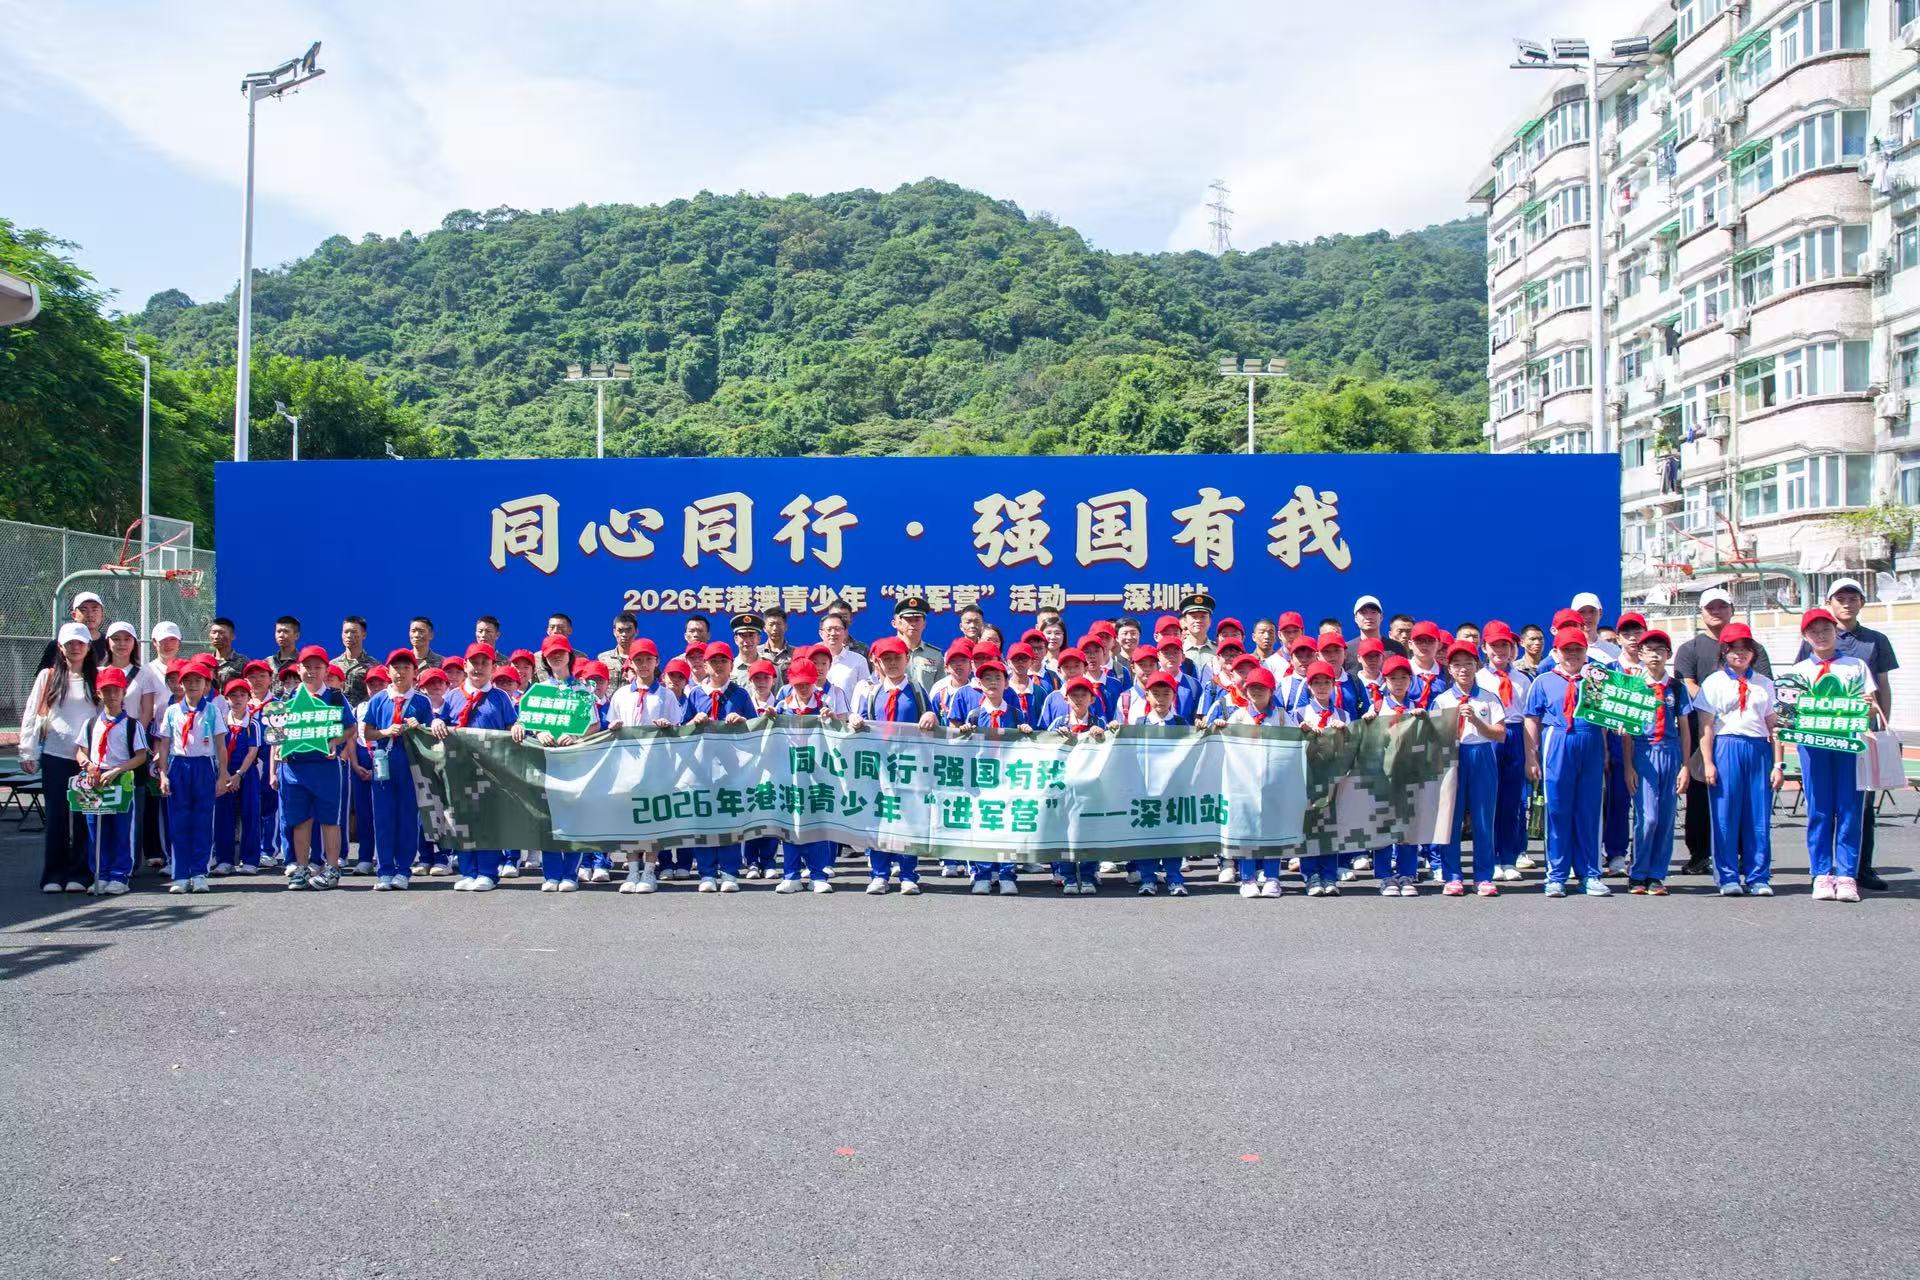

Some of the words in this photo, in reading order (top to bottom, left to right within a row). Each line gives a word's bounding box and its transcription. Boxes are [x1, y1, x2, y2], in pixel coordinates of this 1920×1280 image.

[1798, 696, 1866, 712] 同心同行
[287, 723, 344, 741] 担当有我
[1798, 715, 1868, 732] 强国有我
[1793, 732, 1849, 750] 号角已吹响
